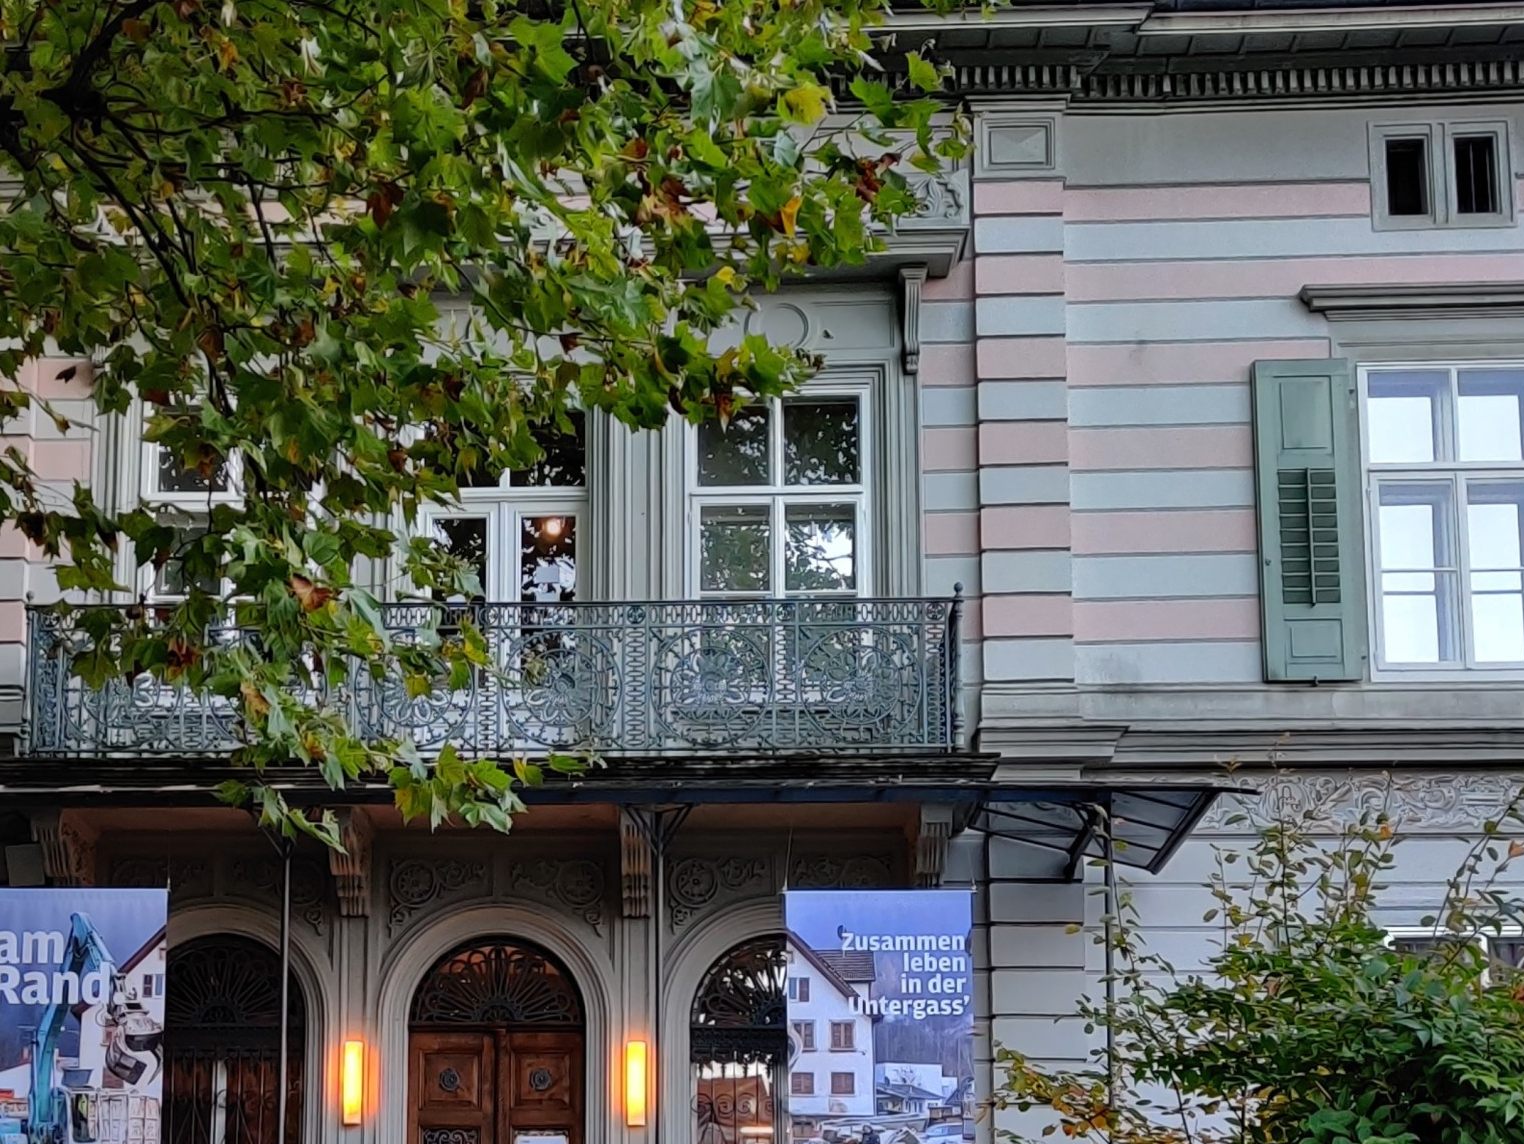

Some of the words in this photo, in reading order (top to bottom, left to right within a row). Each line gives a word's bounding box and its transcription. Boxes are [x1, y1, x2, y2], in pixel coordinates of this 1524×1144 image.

[0, 931, 64, 964] am
[841, 932, 965, 951] Zusammen
[903, 952, 966, 972] leben
[901, 973, 922, 993] in
[927, 973, 967, 993] der
